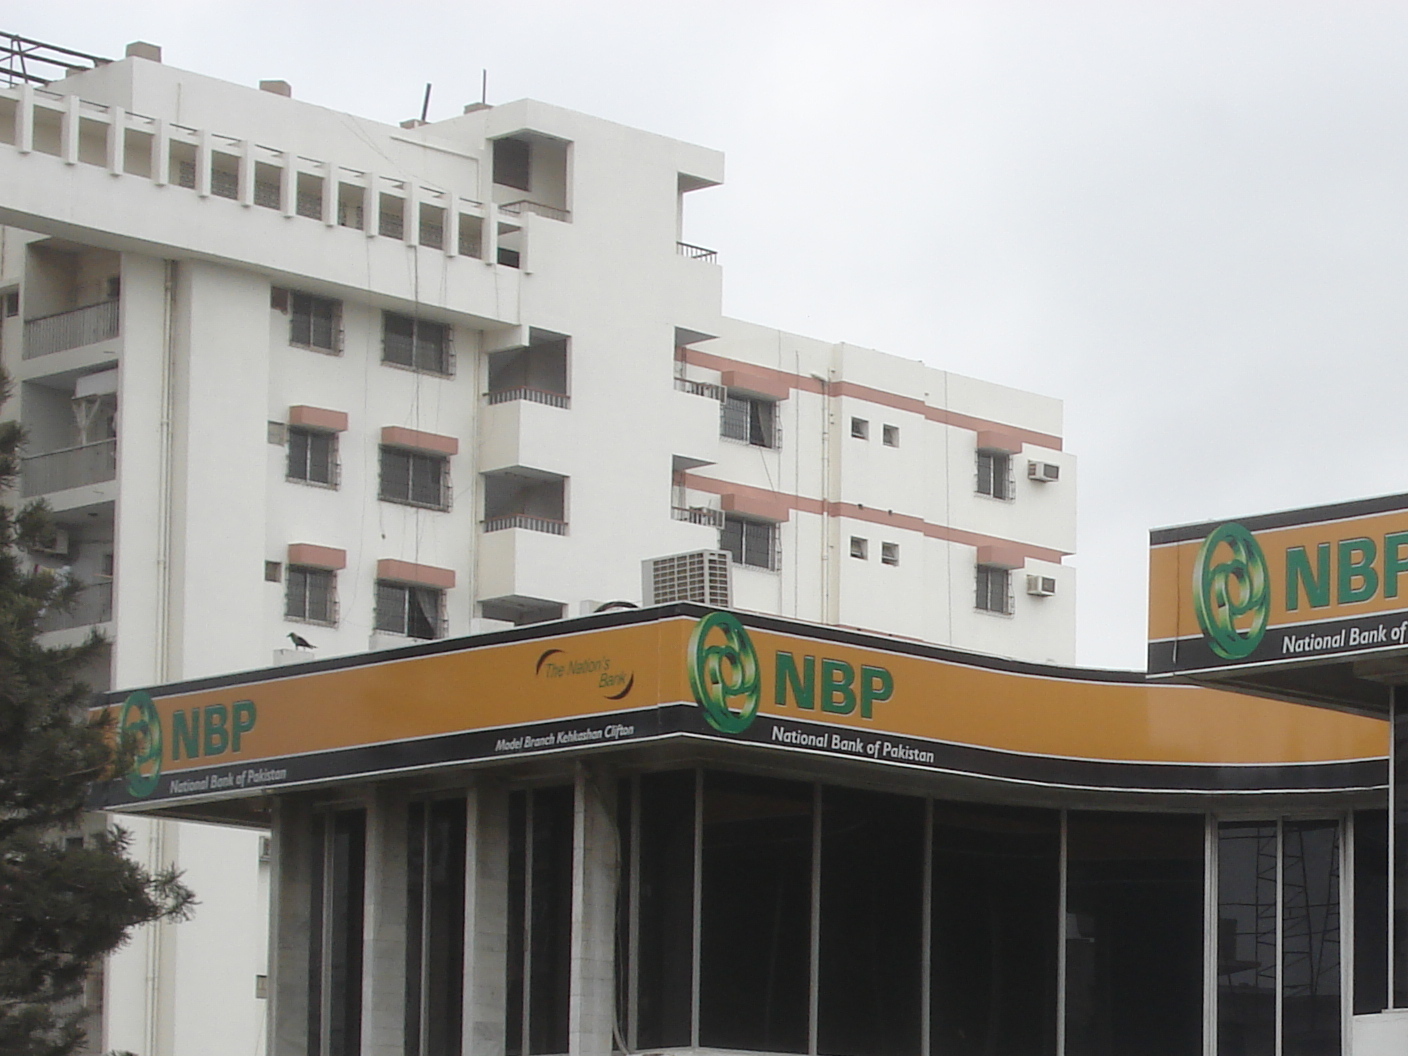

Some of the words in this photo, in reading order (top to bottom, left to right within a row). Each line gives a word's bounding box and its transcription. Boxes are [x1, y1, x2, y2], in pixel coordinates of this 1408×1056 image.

[1283, 629, 1346, 654] National
[1349, 624, 1387, 646] Bank
[1390, 621, 1408, 644] of
[546, 663, 565, 678] The
[567, 657, 611, 675] Nation's
[599, 671, 627, 688] Bank
[775, 650, 895, 721] NBP
[172, 700, 257, 762] NBP
[495, 738, 523, 751] Model
[524, 733, 555, 748] Branch
[556, 728, 602, 744] Kehkashan
[604, 724, 635, 739] Clifton
[772, 725, 829, 748] National
[831, 734, 863, 753] Bank
[866, 740, 881, 759] of
[883, 742, 935, 763] Pakistan
[170, 775, 209, 794] National
[210, 772, 234, 788] Bank
[235, 770, 247, 787] of
[247, 768, 287, 784] Pakistan
